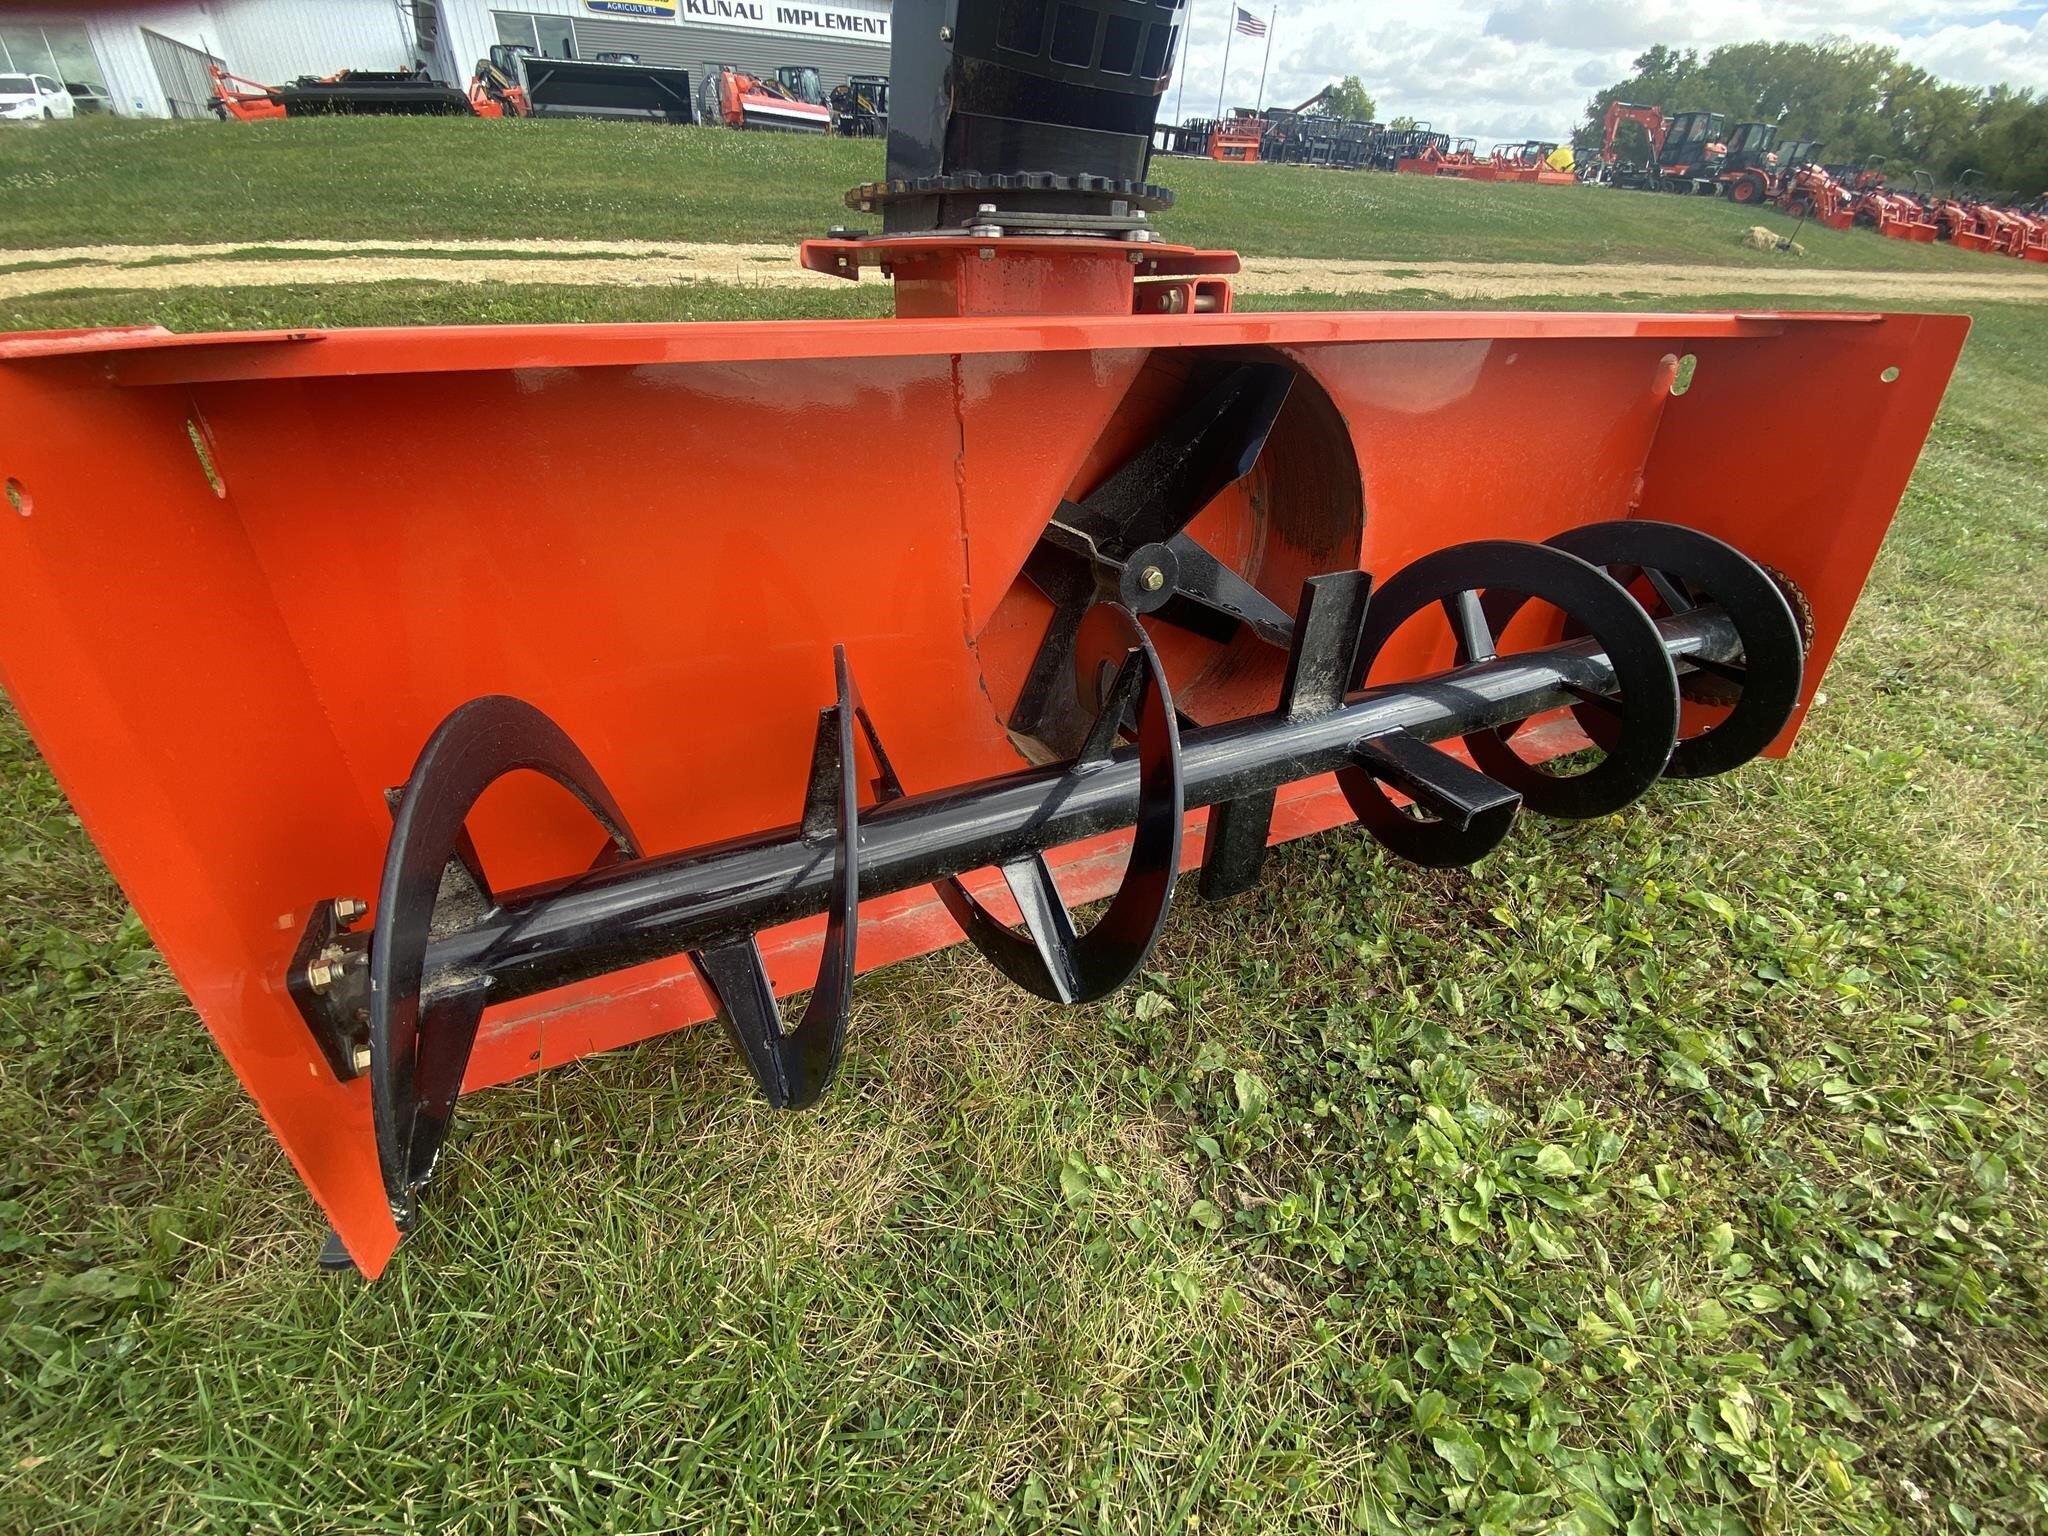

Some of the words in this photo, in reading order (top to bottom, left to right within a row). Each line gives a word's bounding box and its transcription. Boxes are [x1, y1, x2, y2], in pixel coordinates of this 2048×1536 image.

[607, 2, 657, 14] AGRICULTURE
[687, 0, 763, 20] KUNAU
[777, 7, 887, 35] IMPLEMENT
